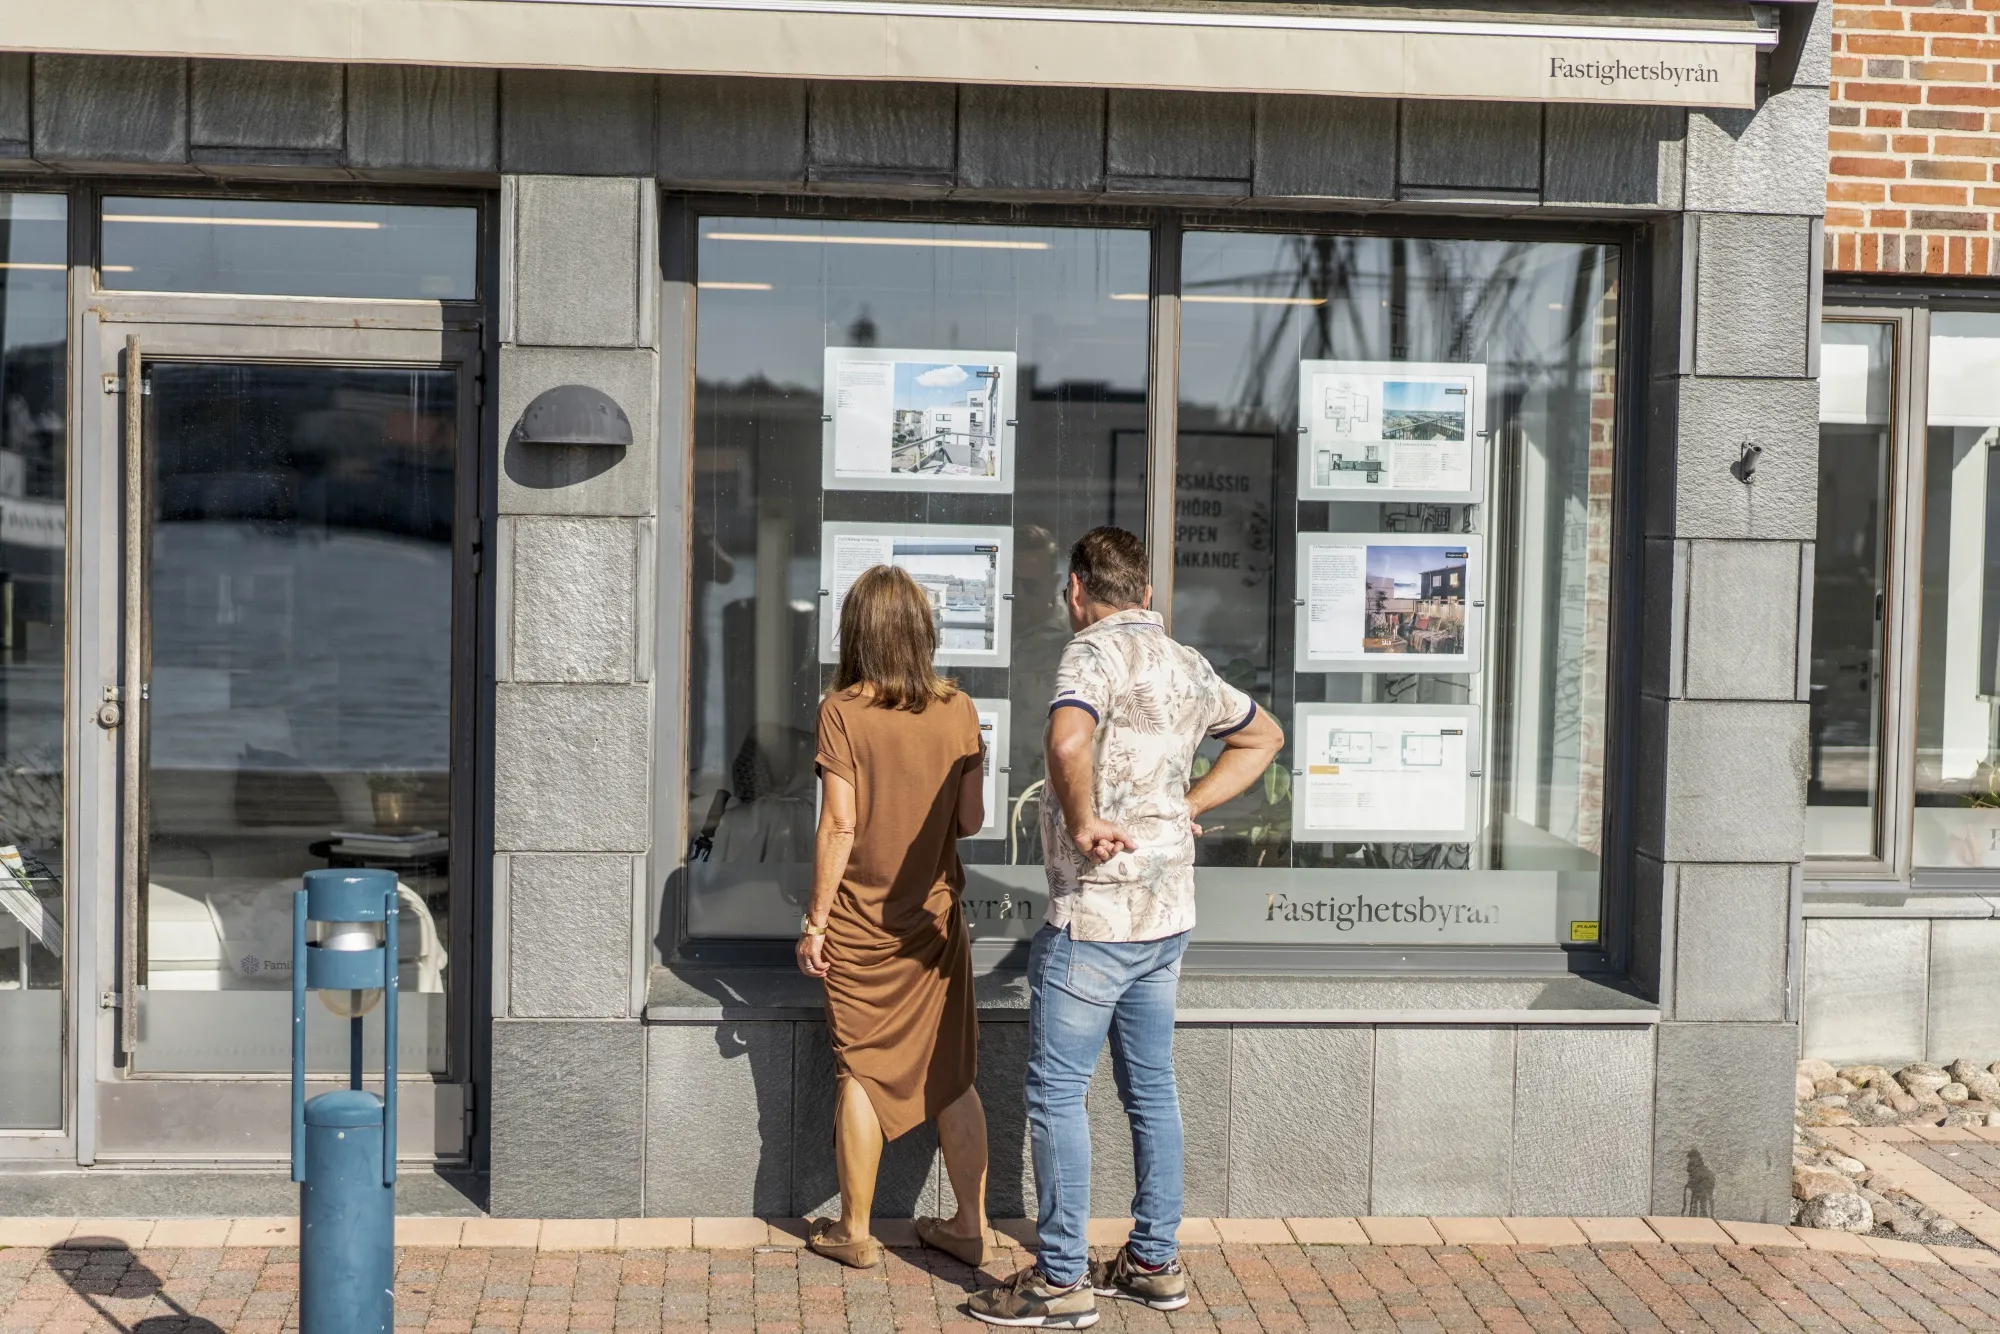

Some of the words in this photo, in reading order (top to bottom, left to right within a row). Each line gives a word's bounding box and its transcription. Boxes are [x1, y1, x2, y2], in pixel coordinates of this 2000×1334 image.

[1549, 57, 1720, 87] Fastighetsbyrån
[1176, 472, 1250, 493] RSMÄSSIG
[1175, 525, 1217, 543] PPEN
[264, 960, 294, 970] Famil
